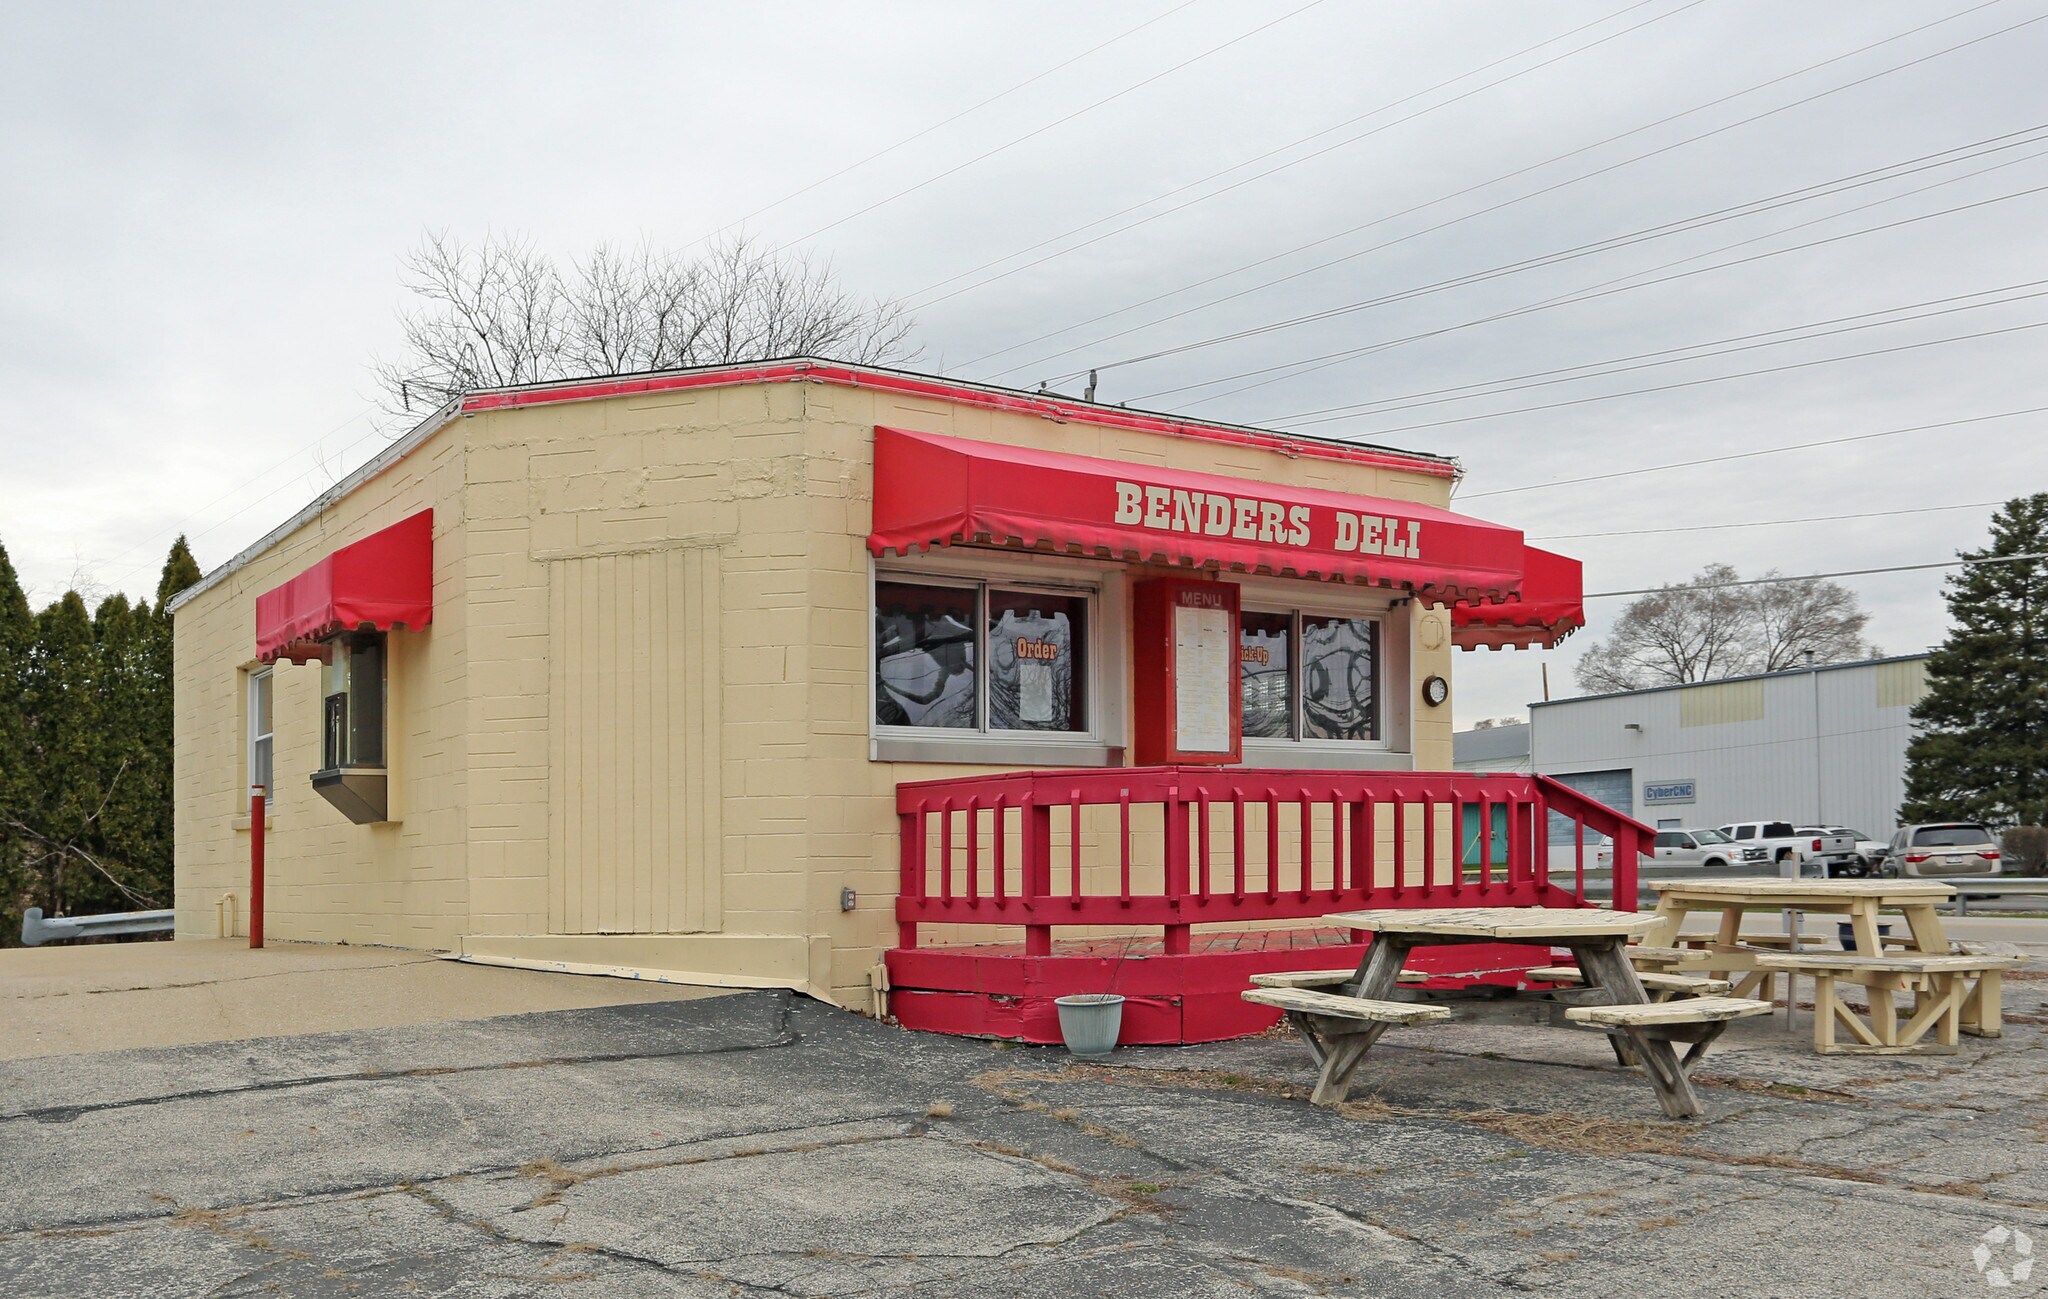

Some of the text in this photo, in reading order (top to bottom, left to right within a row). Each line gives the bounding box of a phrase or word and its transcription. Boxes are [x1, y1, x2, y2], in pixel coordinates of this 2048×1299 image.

[1114, 481, 1421, 559] BENDERS DELI
[1181, 591, 1222, 607] MENU
[1016, 636, 1057, 660] Order
[1241, 645, 1268, 666] ick-Up
[1646, 785, 1692, 800] CyberCNC
